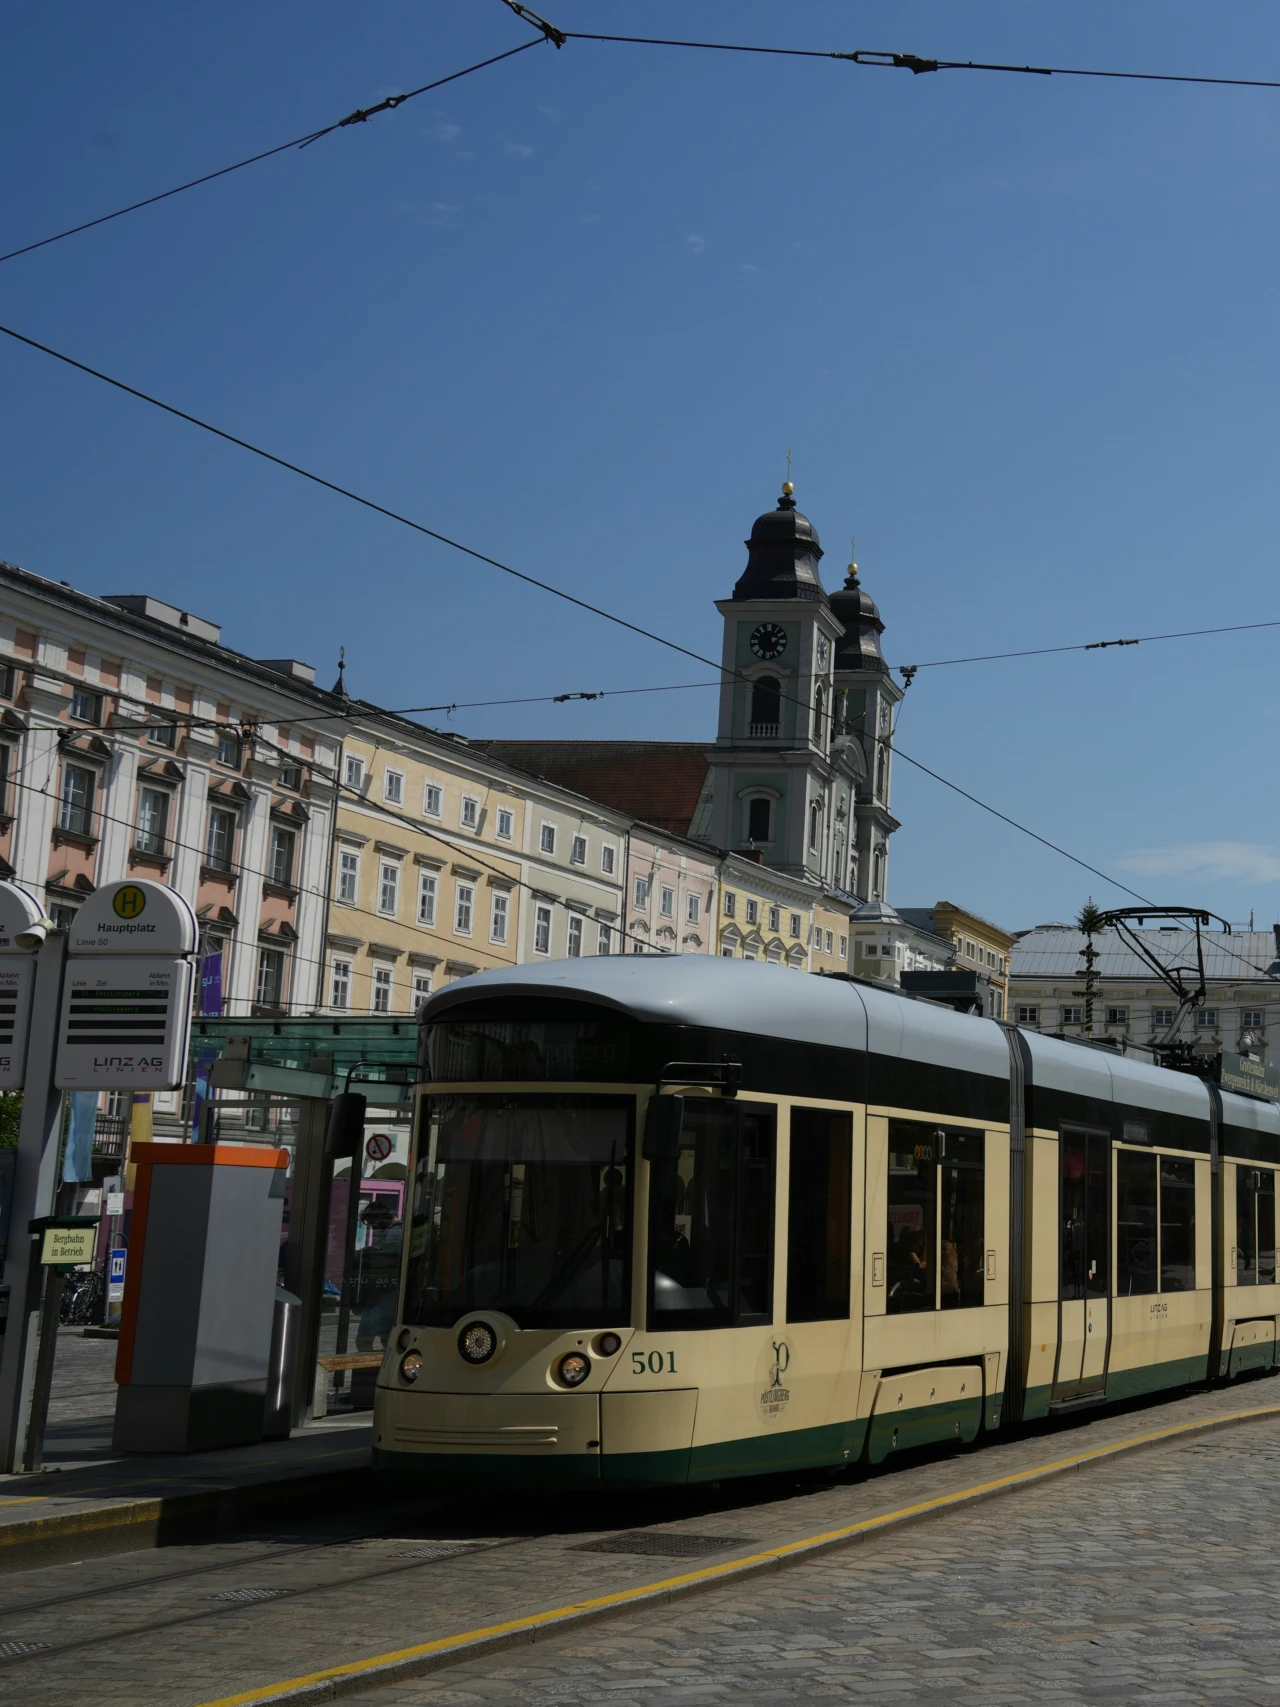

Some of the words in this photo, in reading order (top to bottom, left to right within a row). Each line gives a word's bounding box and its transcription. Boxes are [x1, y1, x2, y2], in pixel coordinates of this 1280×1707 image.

[121, 892, 137, 912] H
[97, 923, 156, 934] Hauptplatz
[76, 938, 96, 946] Linie
[98, 938, 108, 946] 50
[94, 1057, 134, 1067] LINZ
[137, 1057, 163, 1067] AG
[1221, 1068, 1250, 1090] Zwergenreich
[53, 1233, 85, 1245] Bergbahn
[51, 1247, 58, 1256] in
[59, 1247, 84, 1257] Betrieb
[632, 1350, 678, 1375] 501
[768, 1404, 780, 1413] BAHN
